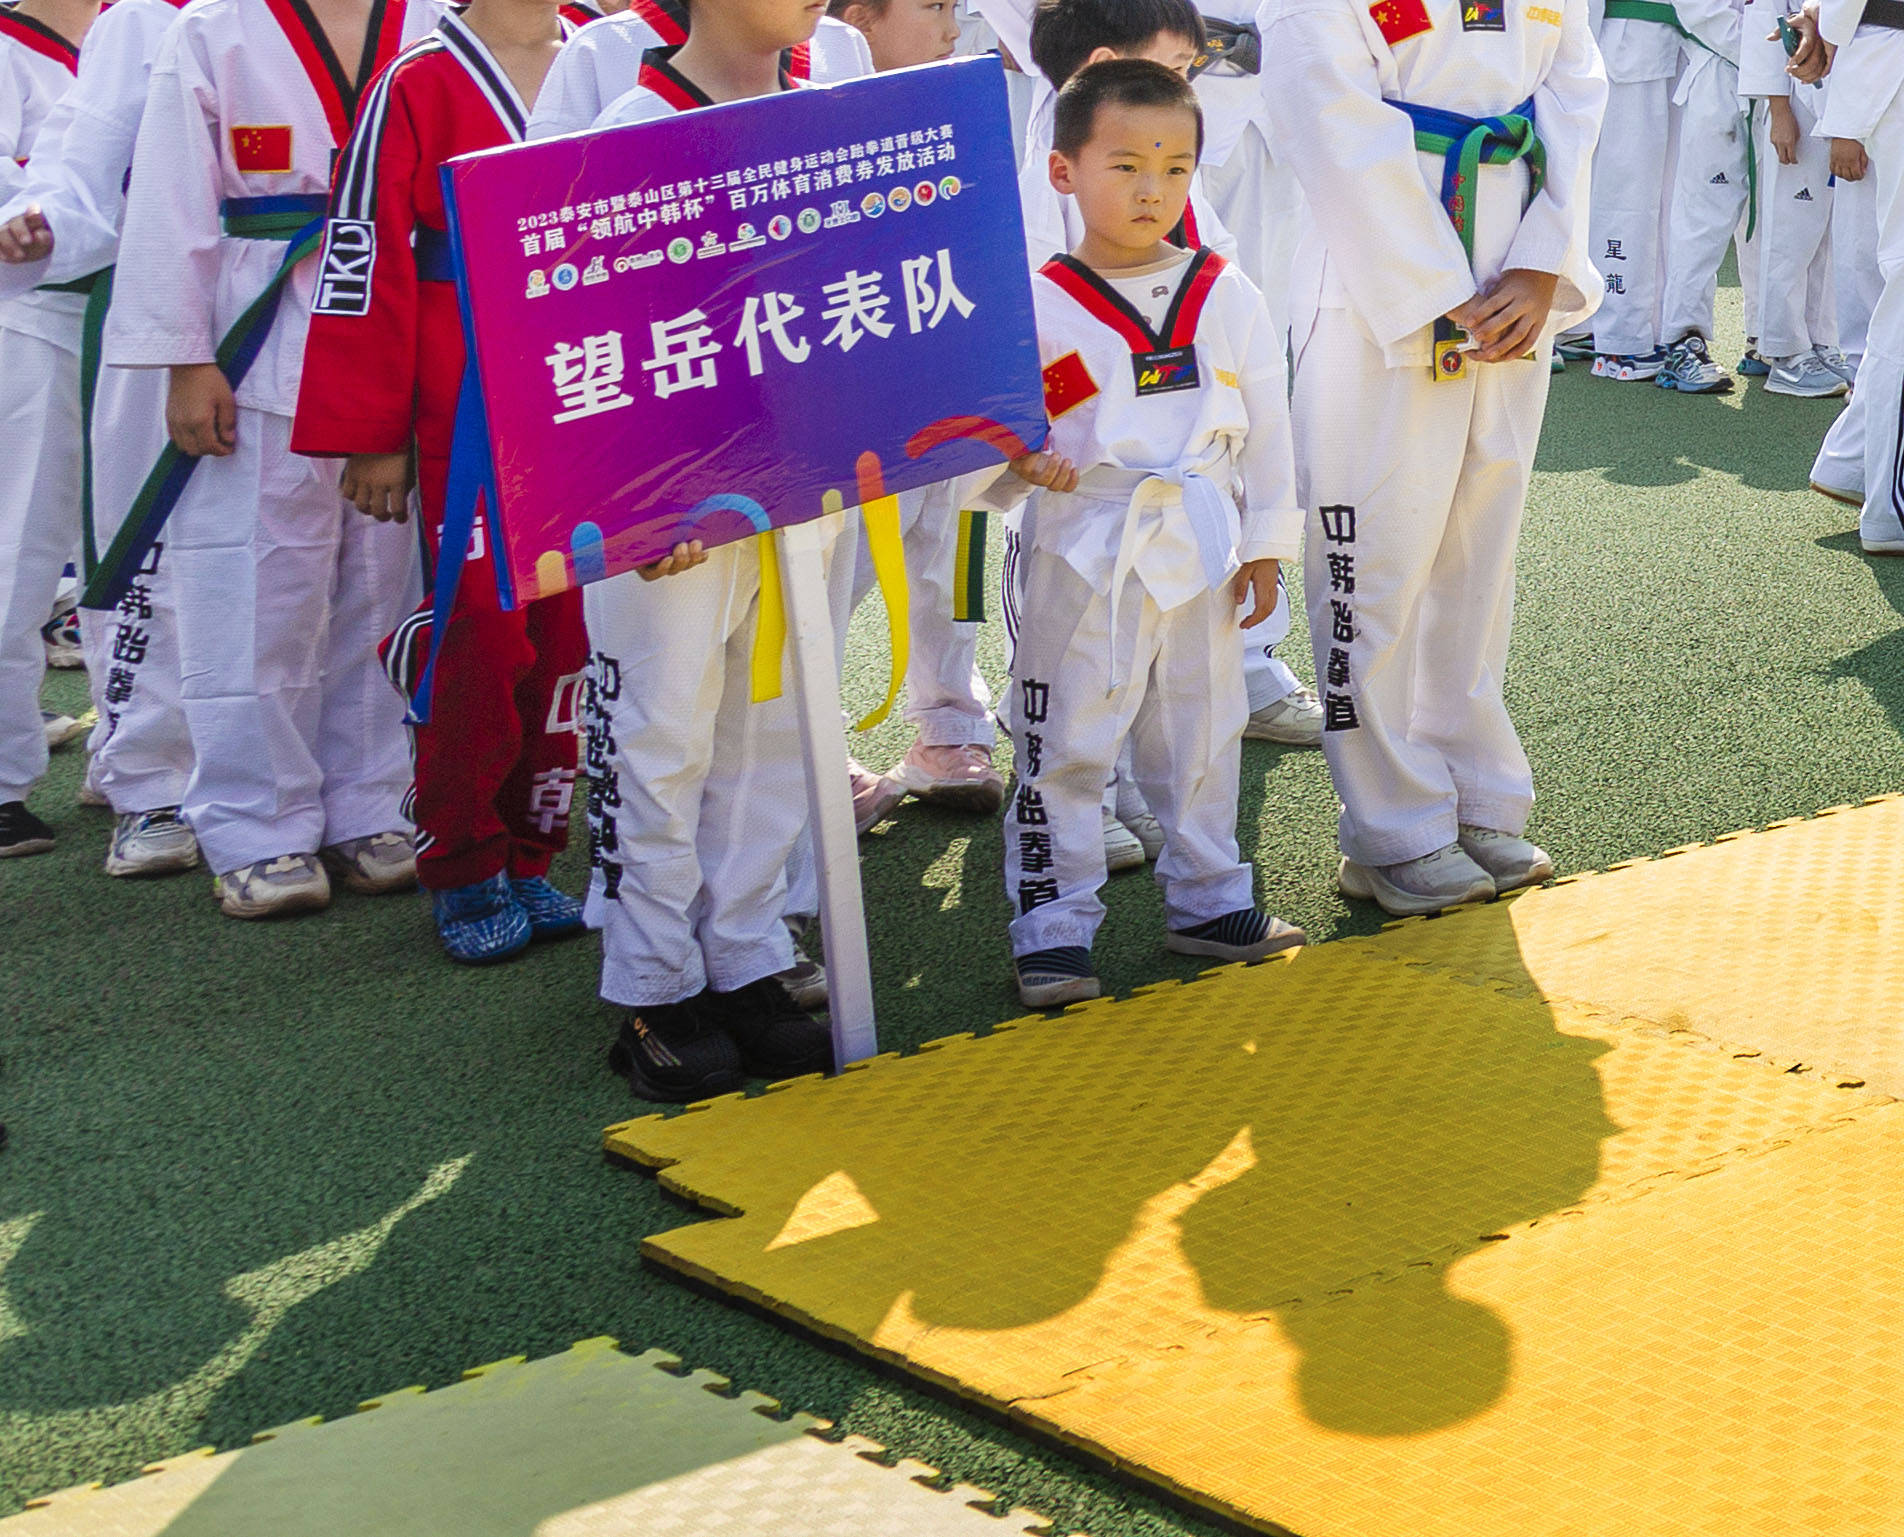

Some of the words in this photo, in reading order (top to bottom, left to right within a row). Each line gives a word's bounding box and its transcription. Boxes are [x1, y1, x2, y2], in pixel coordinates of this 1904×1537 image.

[517, 123, 954, 232] 2023泰安市暨泰山区第十三届全民健身运动会跆拳道晋级大赛
[545, 249, 976, 424] 望岳代表队
[1604, 239, 1627, 295] 星龍
[1318, 504, 1361, 732] 中韩跆拳道
